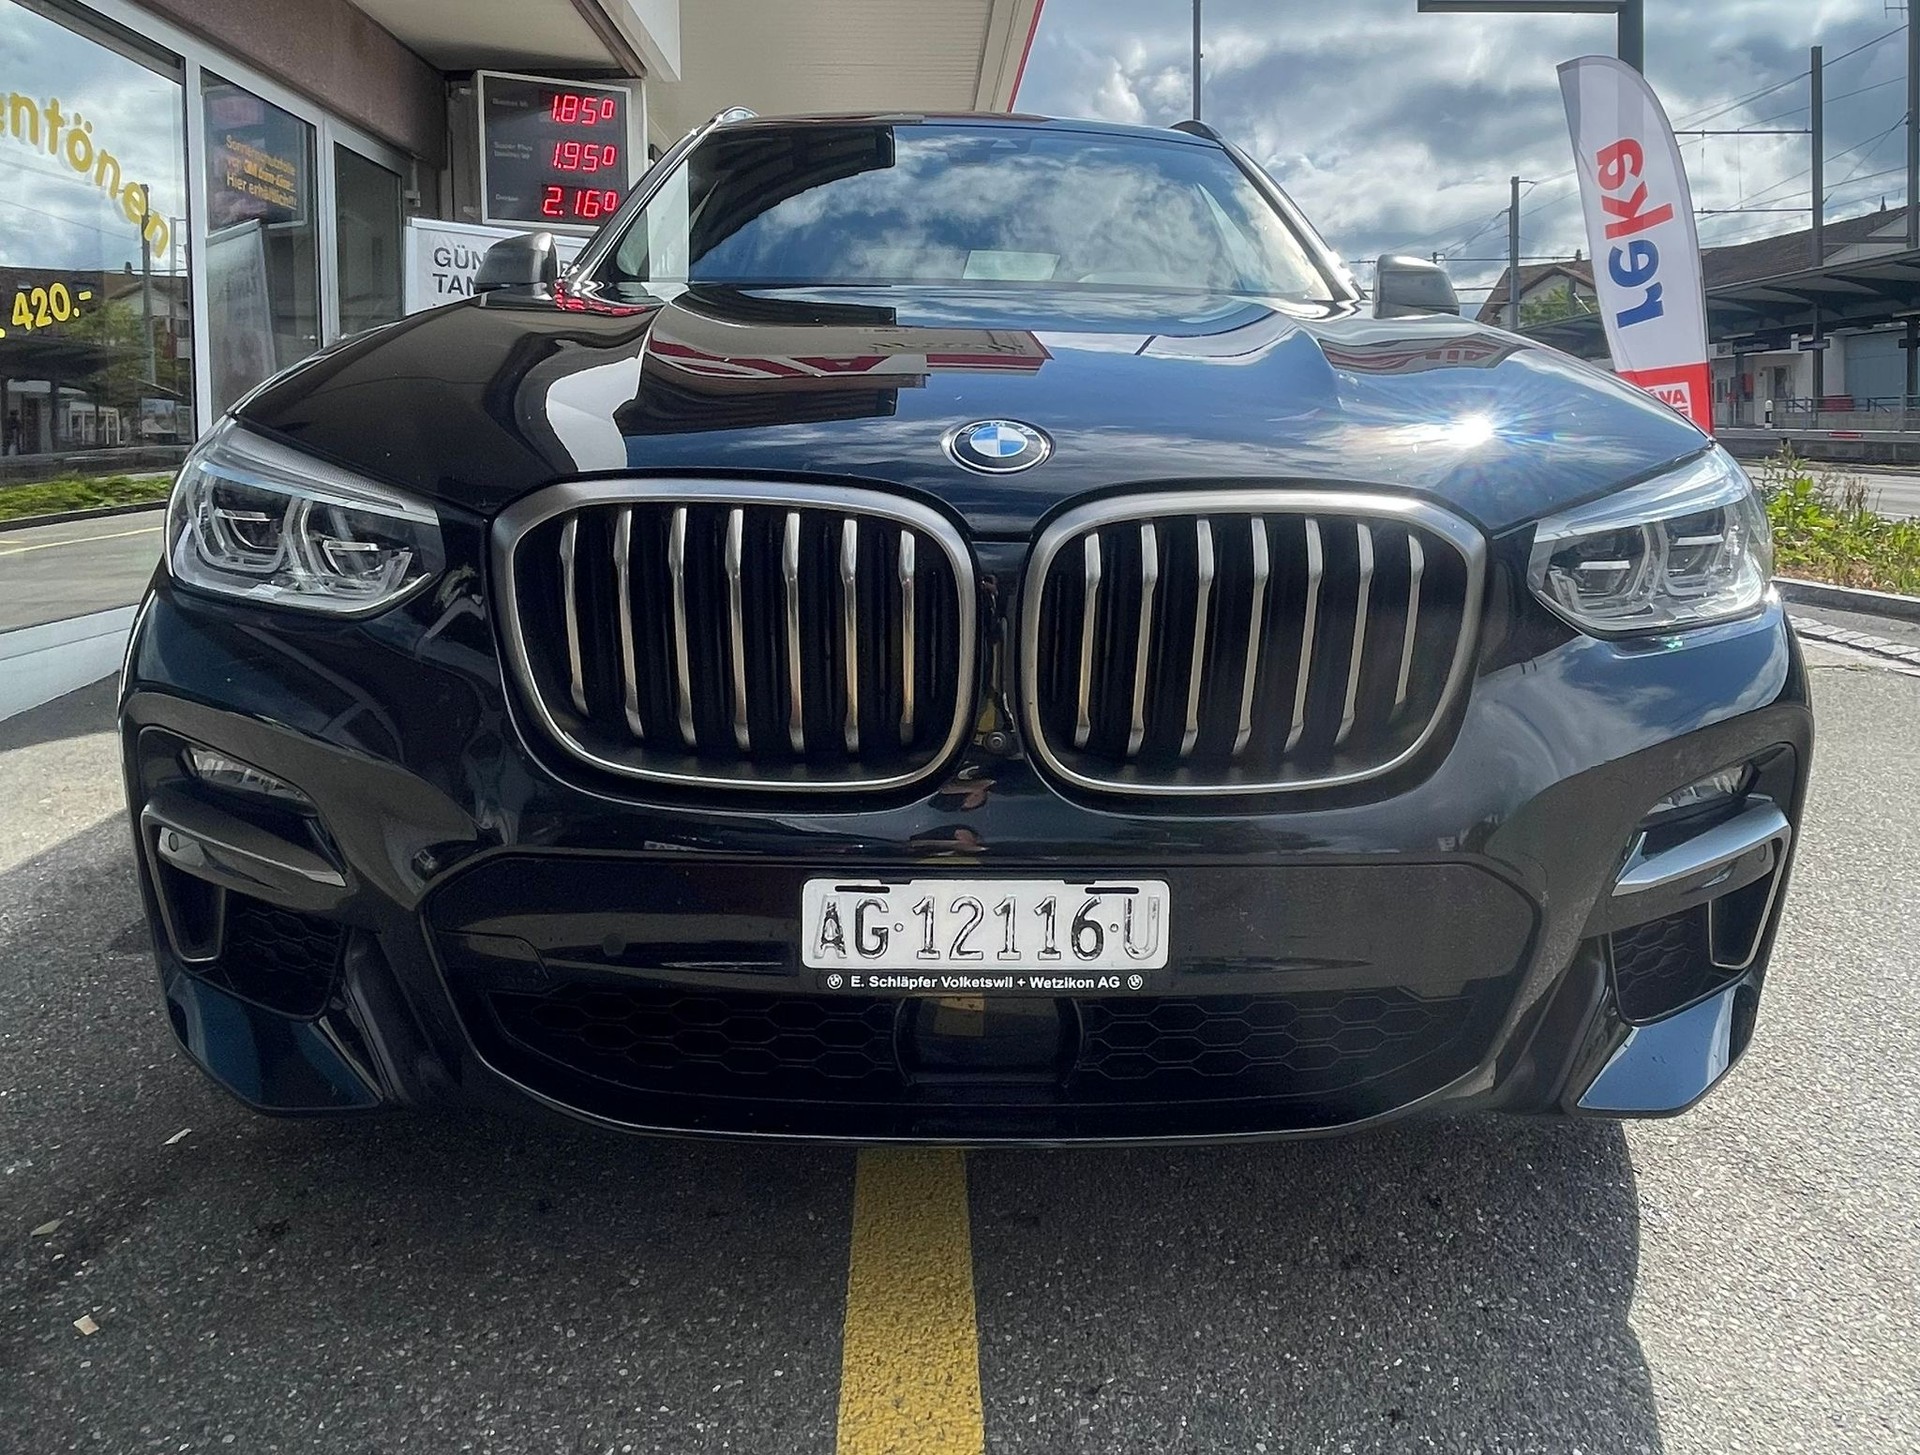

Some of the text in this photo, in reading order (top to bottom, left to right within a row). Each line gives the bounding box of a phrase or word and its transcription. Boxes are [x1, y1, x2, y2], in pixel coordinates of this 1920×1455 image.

[850, 975, 865, 988] E.
[868, 975, 938, 990] Schläpfer
[941, 976, 1014, 988] Volketswil
[1029, 976, 1095, 989] Wetzikon
[1097, 976, 1121, 988] AG
